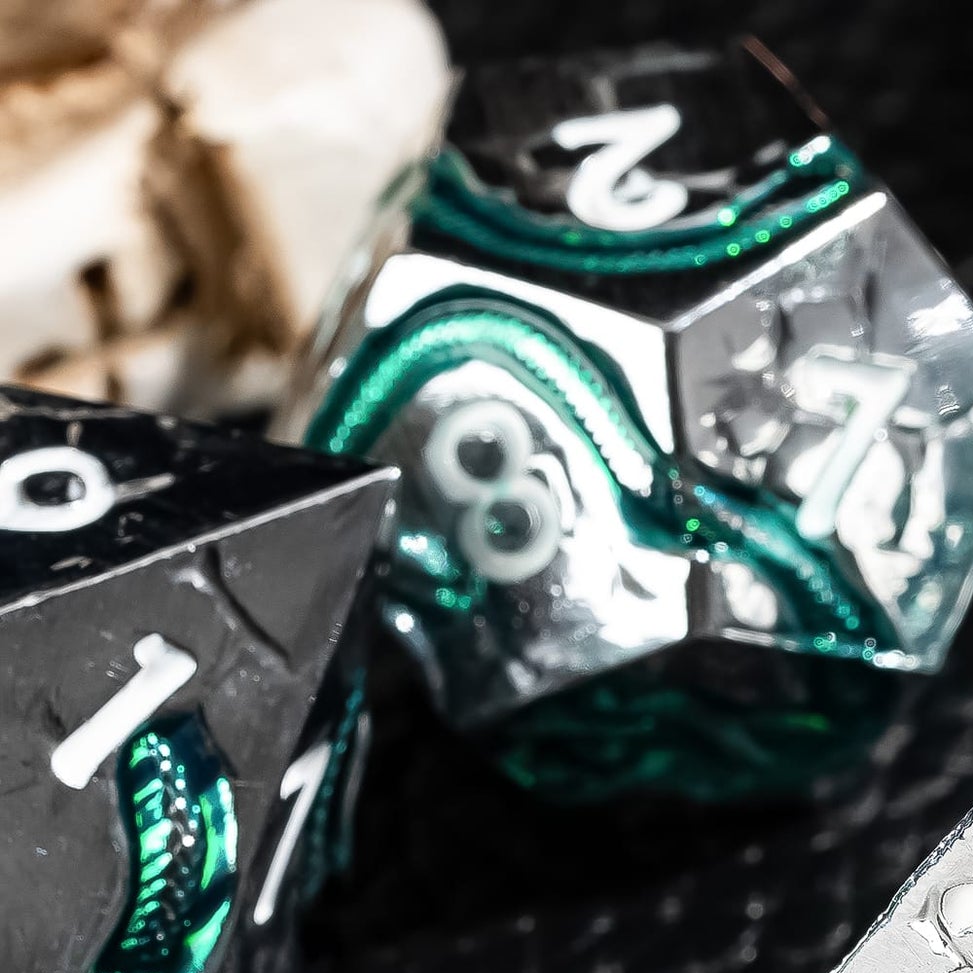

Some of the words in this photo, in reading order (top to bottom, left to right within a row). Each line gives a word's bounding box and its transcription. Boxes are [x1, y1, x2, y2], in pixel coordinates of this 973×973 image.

[553, 103, 689, 232] 2
[424, 400, 562, 584] 8
[785, 352, 916, 538] 7
